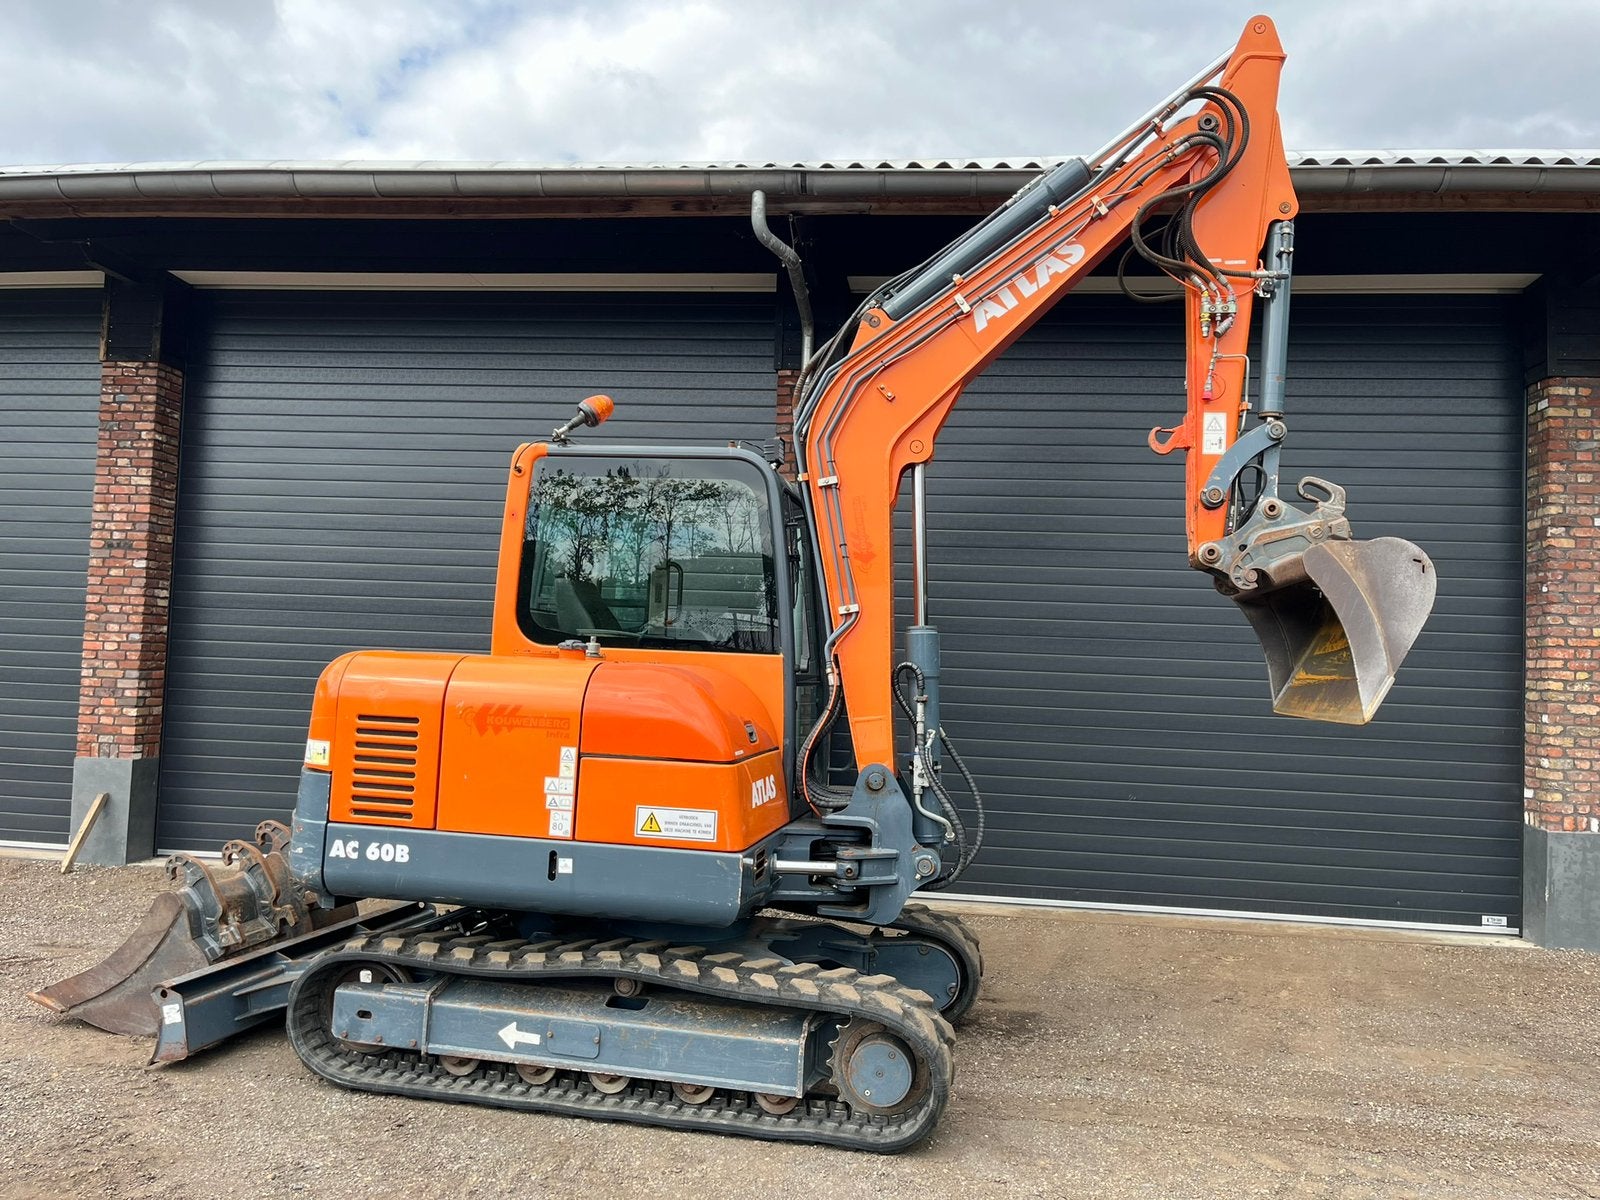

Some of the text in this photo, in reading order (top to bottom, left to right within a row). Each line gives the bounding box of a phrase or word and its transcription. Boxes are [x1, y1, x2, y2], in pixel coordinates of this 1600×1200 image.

[973, 240, 1085, 333] ATLAS
[486, 715, 570, 728] KOUWENBERG
[752, 774, 777, 809] ATLAS
[552, 822, 564, 831] 80
[329, 839, 410, 863] AC 60B
